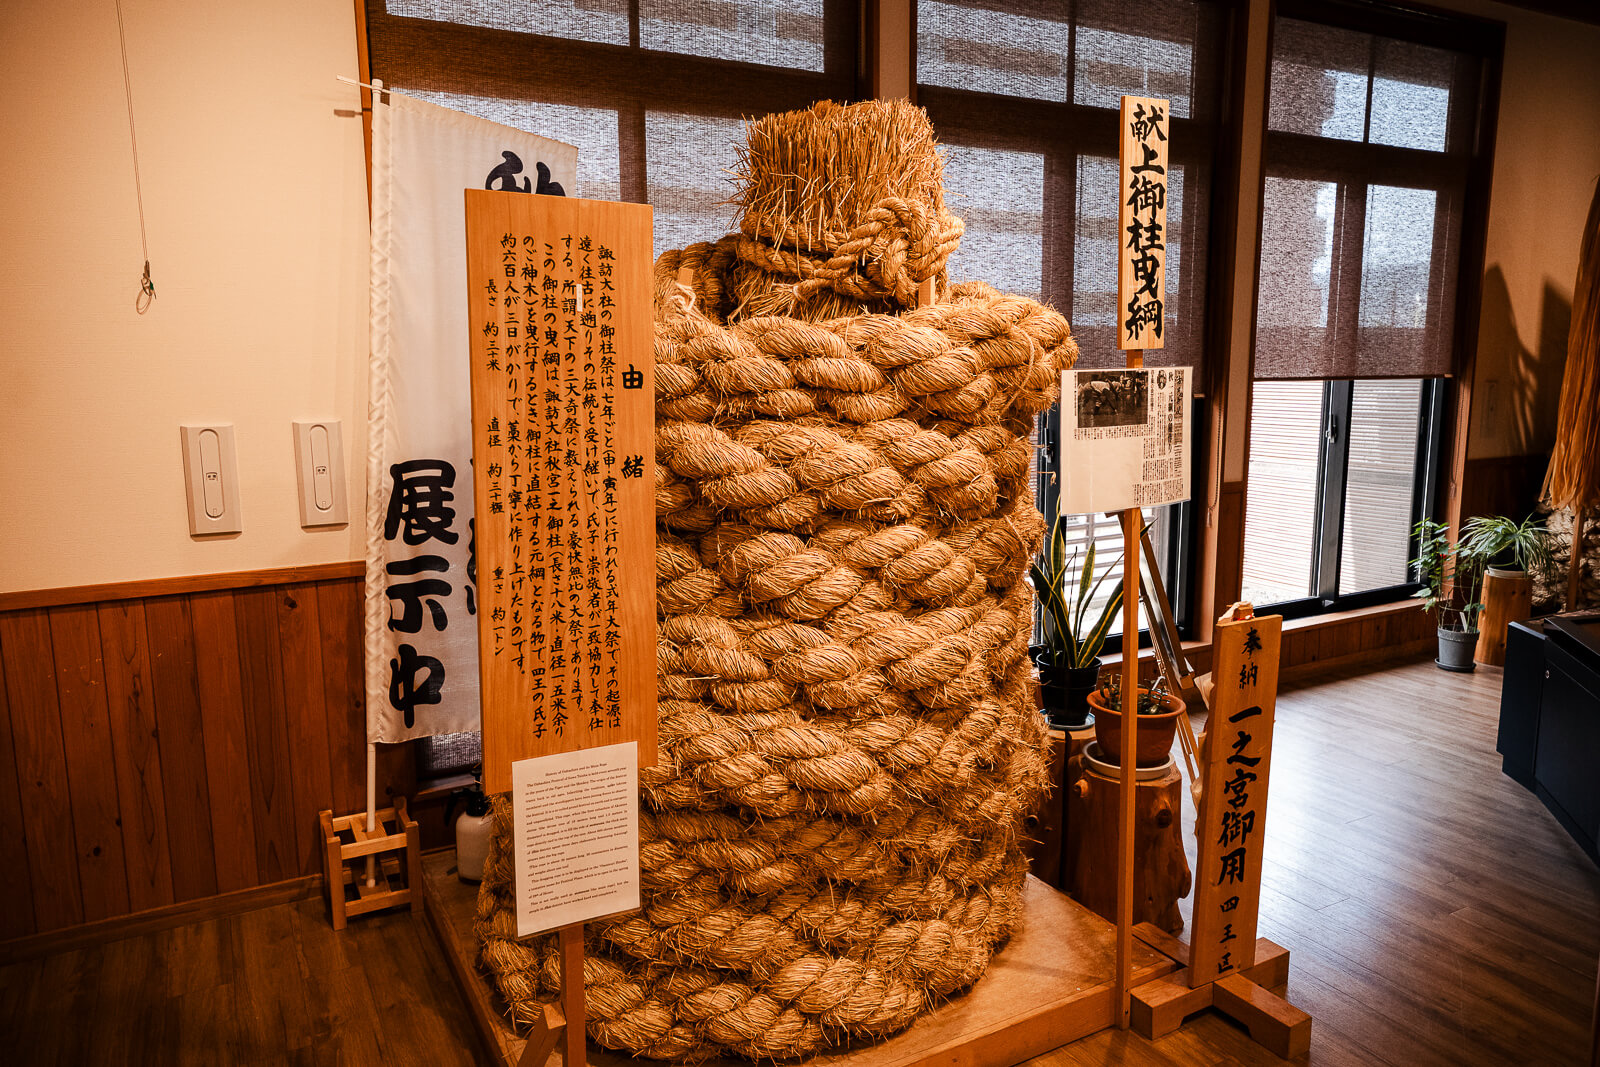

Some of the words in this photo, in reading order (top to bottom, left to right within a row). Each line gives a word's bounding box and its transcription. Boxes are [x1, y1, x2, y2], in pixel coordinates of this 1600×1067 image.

[1126, 103, 1167, 341] 献上御柱曳綱
[484, 278, 499, 307] 長さ
[482, 321, 501, 372] 約三十米
[487, 416, 503, 448] 直径
[384, 459, 460, 729] 展示中
[492, 566, 505, 594] 重さ
[490, 606, 507, 657] 約一トン
[1238, 626, 1263, 690] 奉納
[1217, 704, 1263, 887] 一之宮御用
